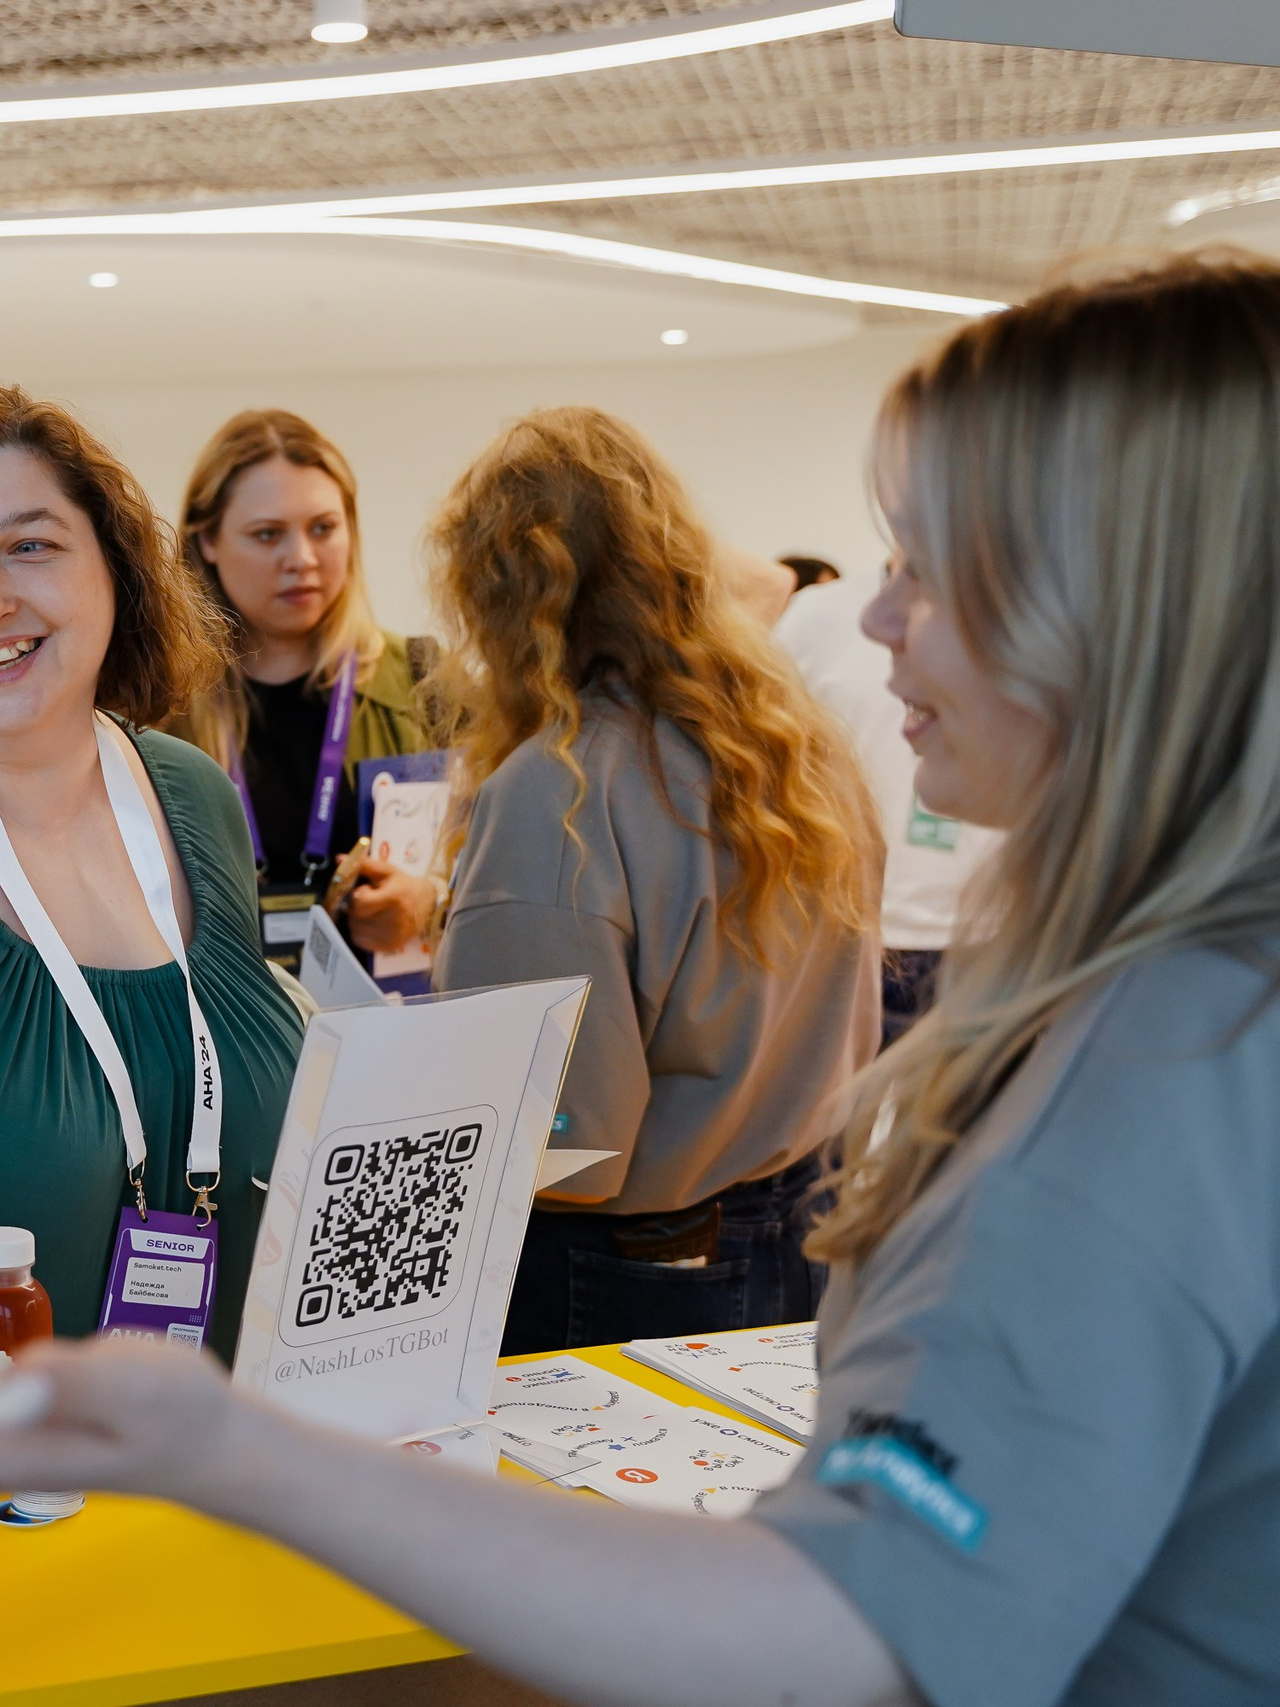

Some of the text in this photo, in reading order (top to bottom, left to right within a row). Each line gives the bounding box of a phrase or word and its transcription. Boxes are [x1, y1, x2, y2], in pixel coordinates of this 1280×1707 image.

[146, 1239, 195, 1253] SENIOR
[133, 1262, 182, 1273] Samokat.tech
[130, 1280, 165, 1289] Надежда
[129, 1289, 169, 1299] Байбекова
[275, 1327, 449, 1382] @NashLosTGBot
[522, 1375, 587, 1388] насколько
[690, 1418, 791, 1457] уже смотрю
